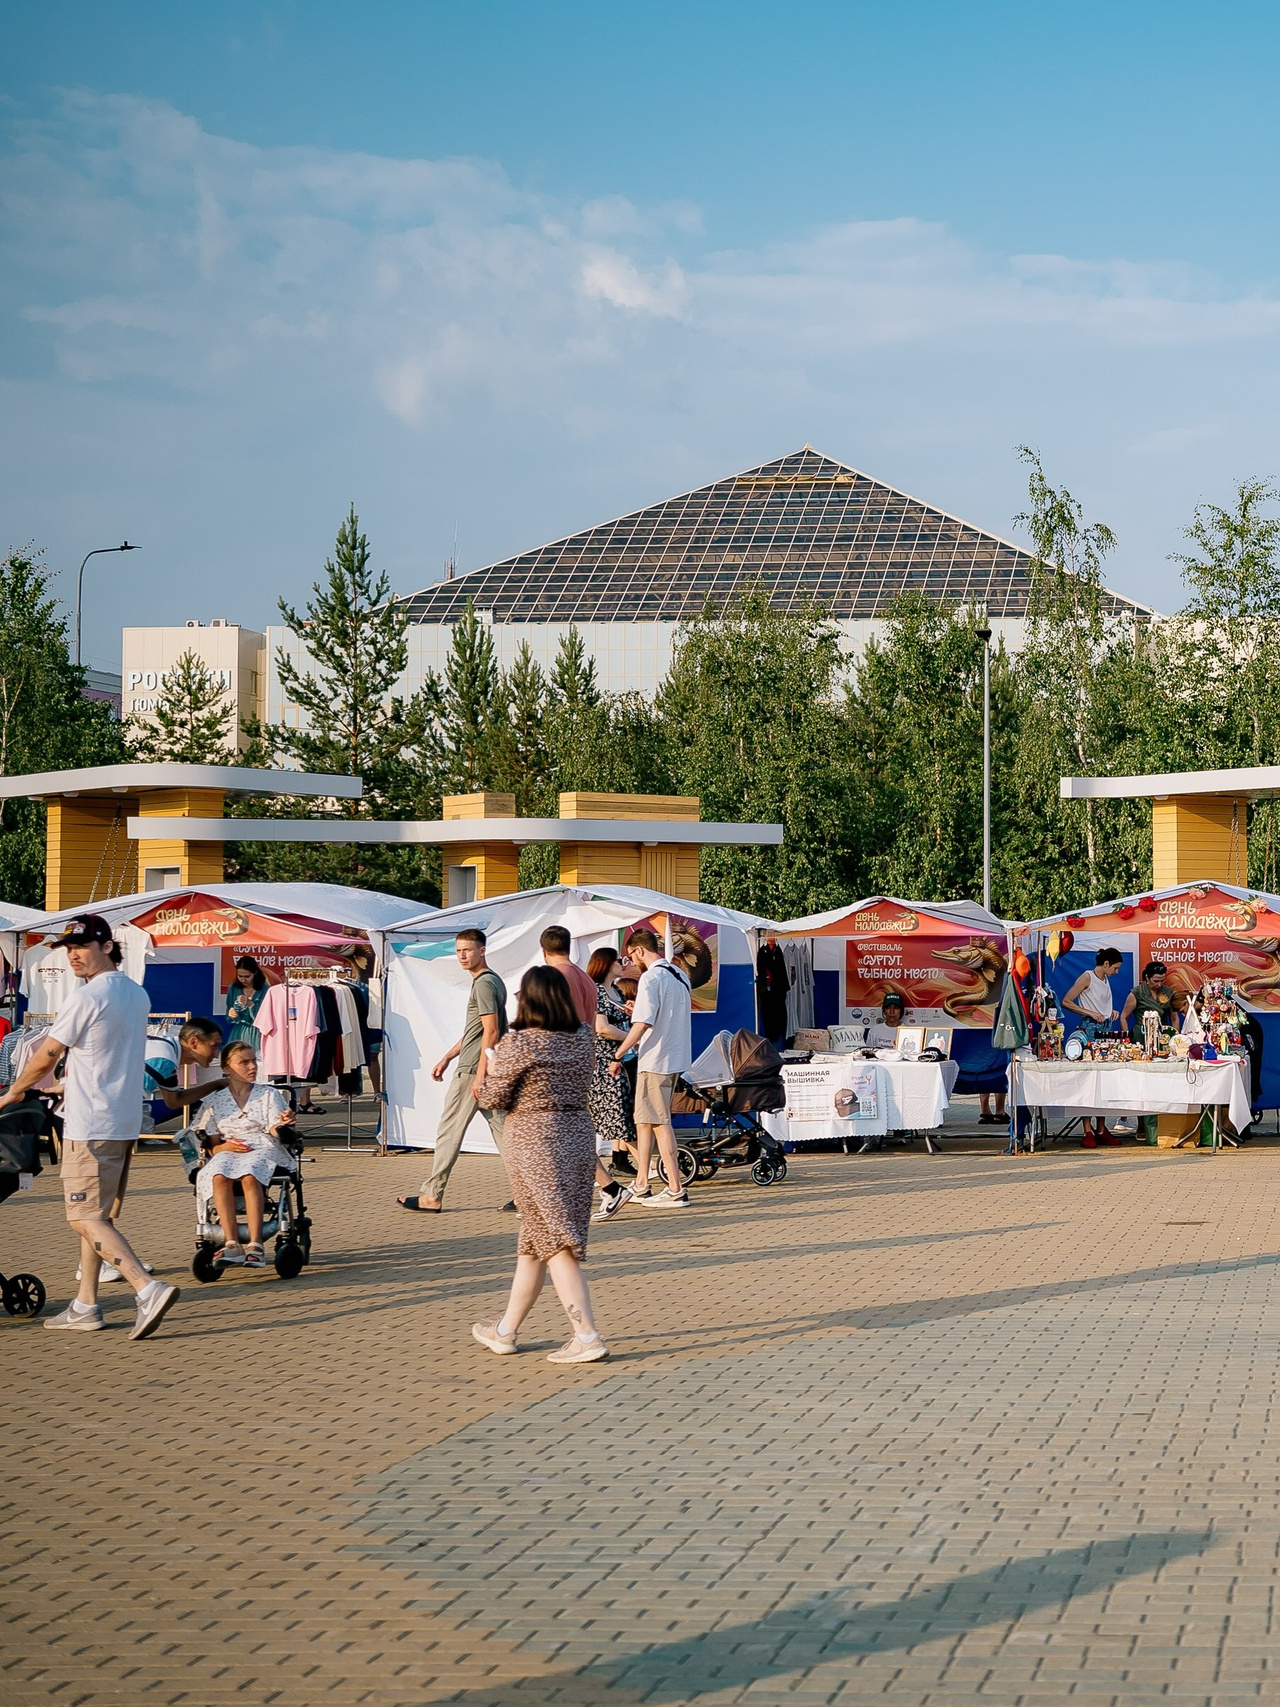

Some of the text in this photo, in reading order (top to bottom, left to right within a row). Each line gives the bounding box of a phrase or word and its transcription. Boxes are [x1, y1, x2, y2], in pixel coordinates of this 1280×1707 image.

[1158, 901, 1197, 914] ДЕНЬ
[155, 908, 191, 922] ДЕНЬ
[855, 912, 880, 922] ДЕНЬ
[1150, 938, 1197, 949] «СУРГУТ.
[232, 955, 276, 967] РНОЕ
[278, 955, 318, 967] МЕСТО»
[858, 954, 903, 966] «СУРГУТ.
[1150, 951, 1239, 962] РЫБНОЕ МЕСТО»
[857, 967, 945, 979] РЫБНОЕ МЕСТО»
